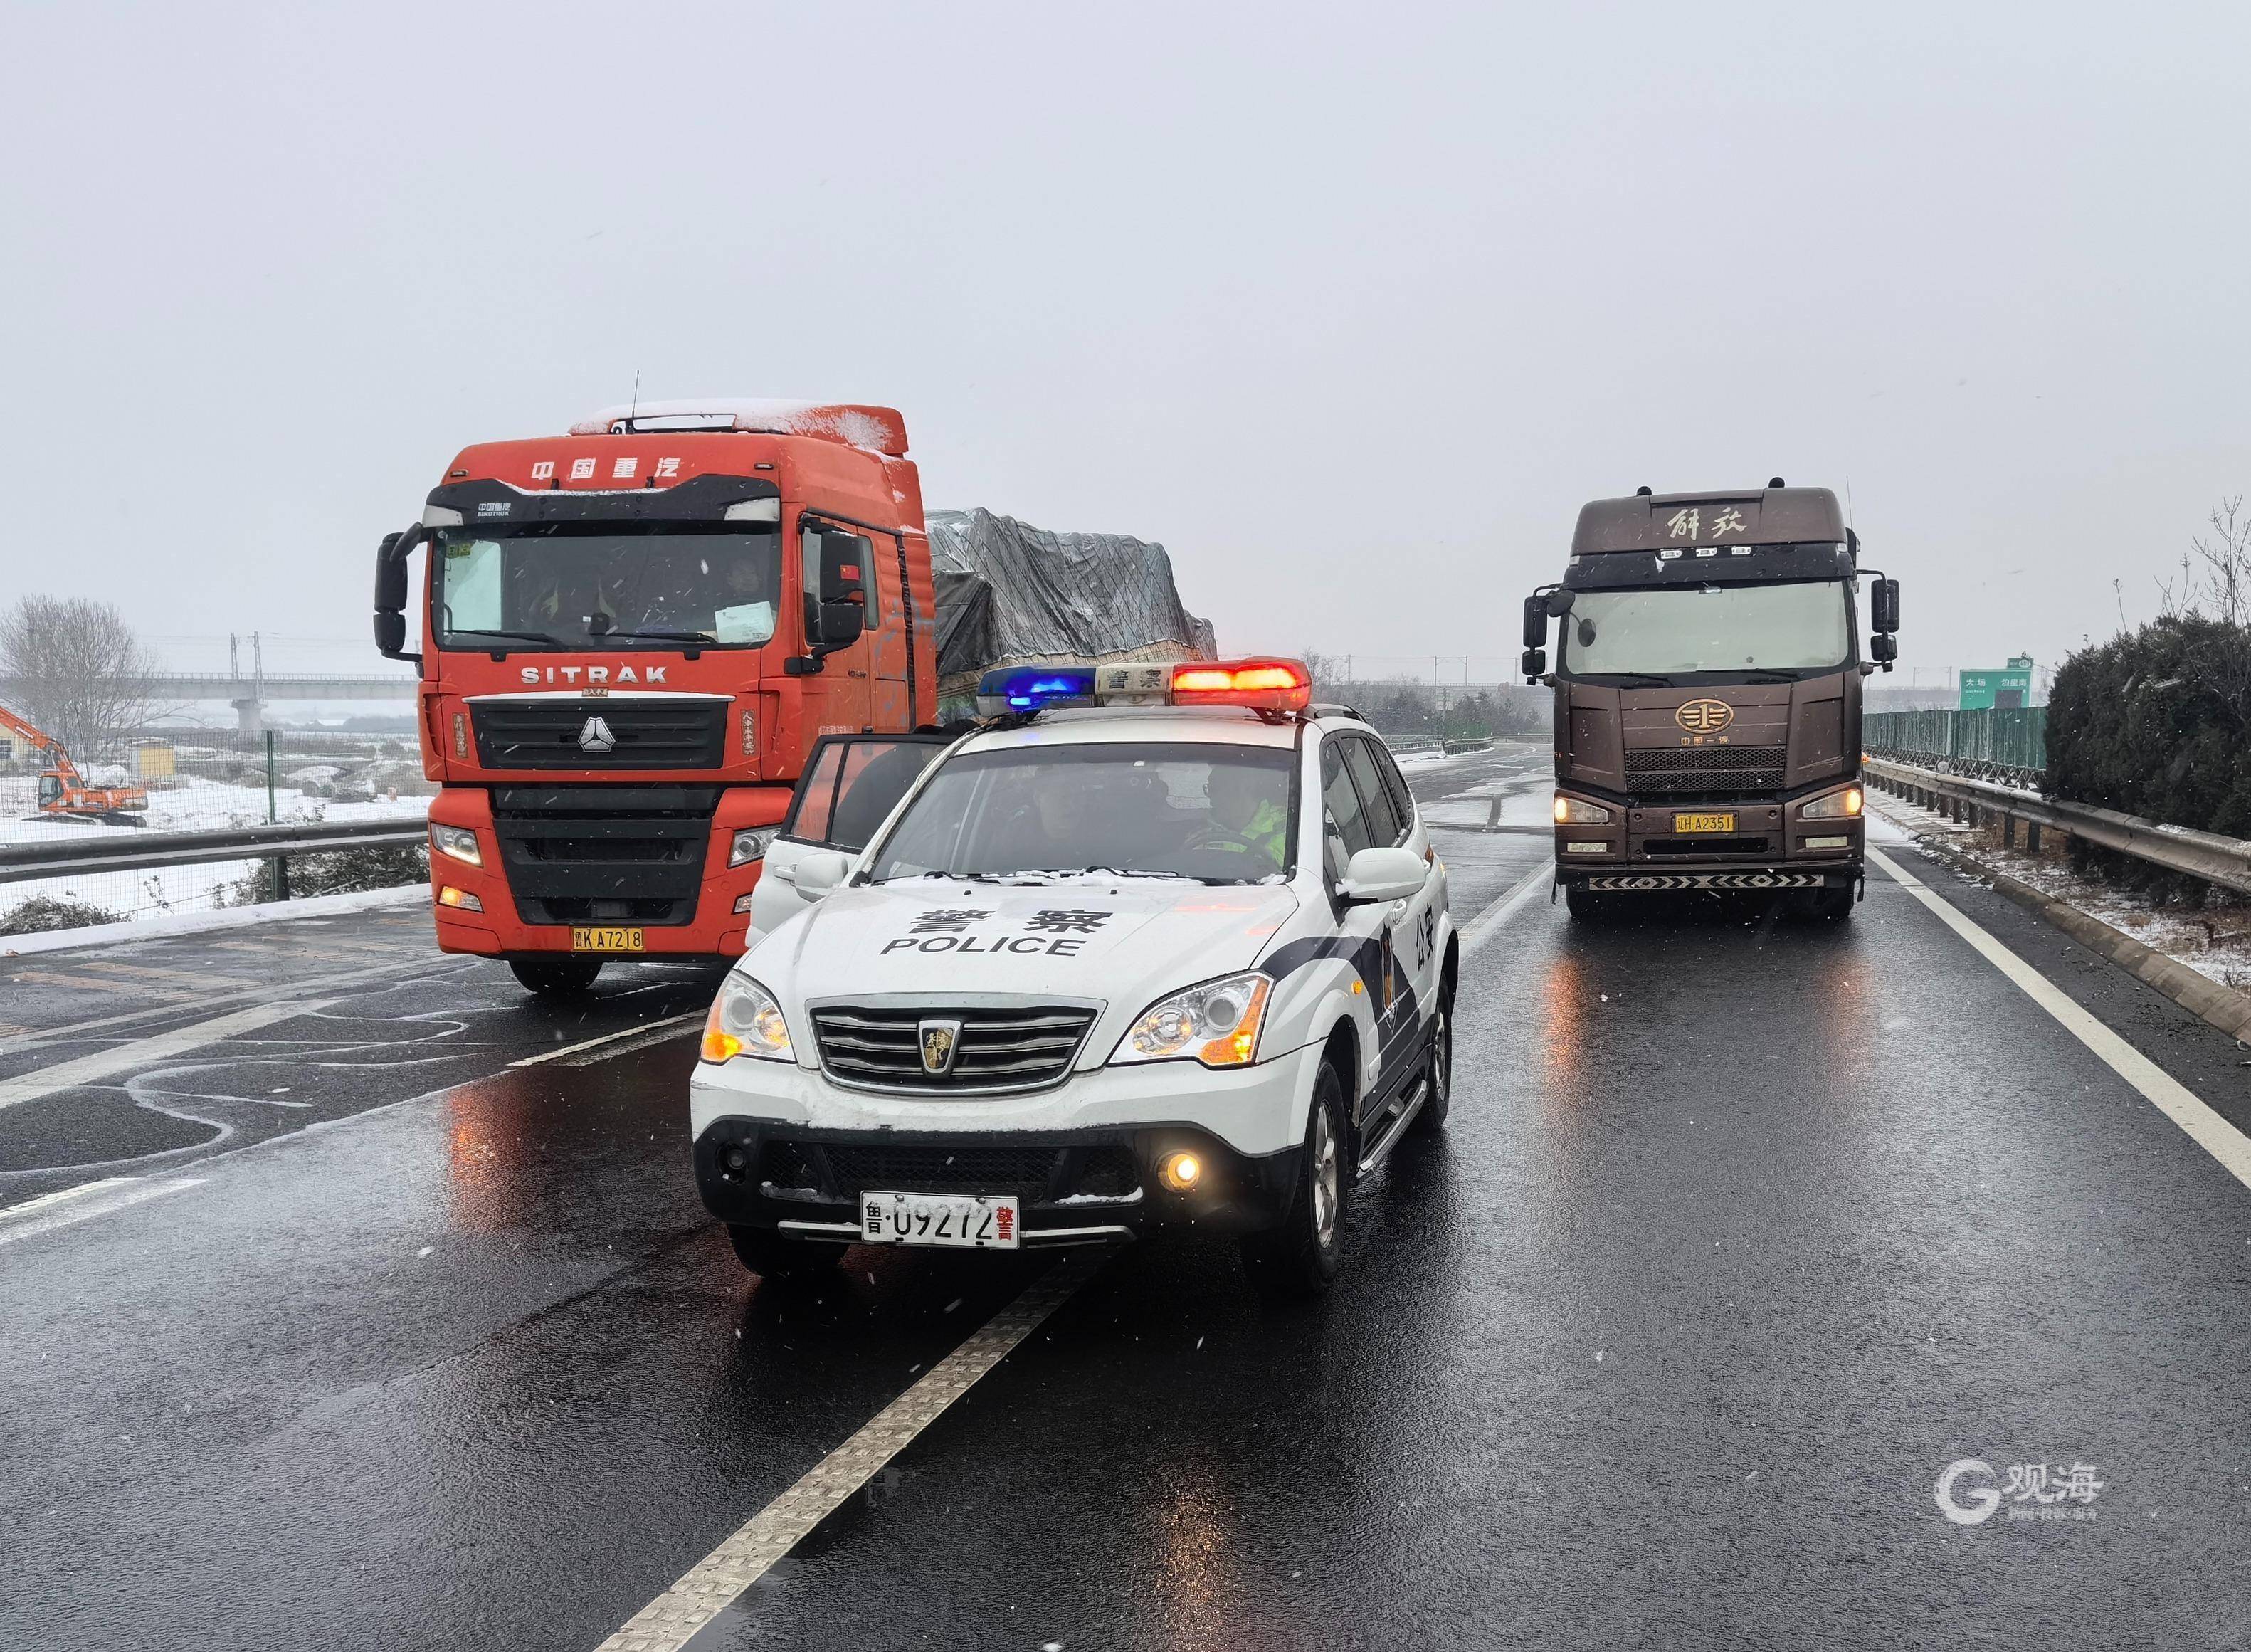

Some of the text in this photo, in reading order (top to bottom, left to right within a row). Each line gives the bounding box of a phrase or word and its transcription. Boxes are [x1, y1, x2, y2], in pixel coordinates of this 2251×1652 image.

[531, 457, 681, 480] 中国重汽
[1667, 507, 1747, 541] 解放
[521, 666, 667, 684] SITRAK
[1107, 668, 1161, 689] 警察
[1680, 735, 1730, 745] 中国一汽
[909, 909, 1114, 935] 警察
[879, 936, 1087, 957] POLICE
